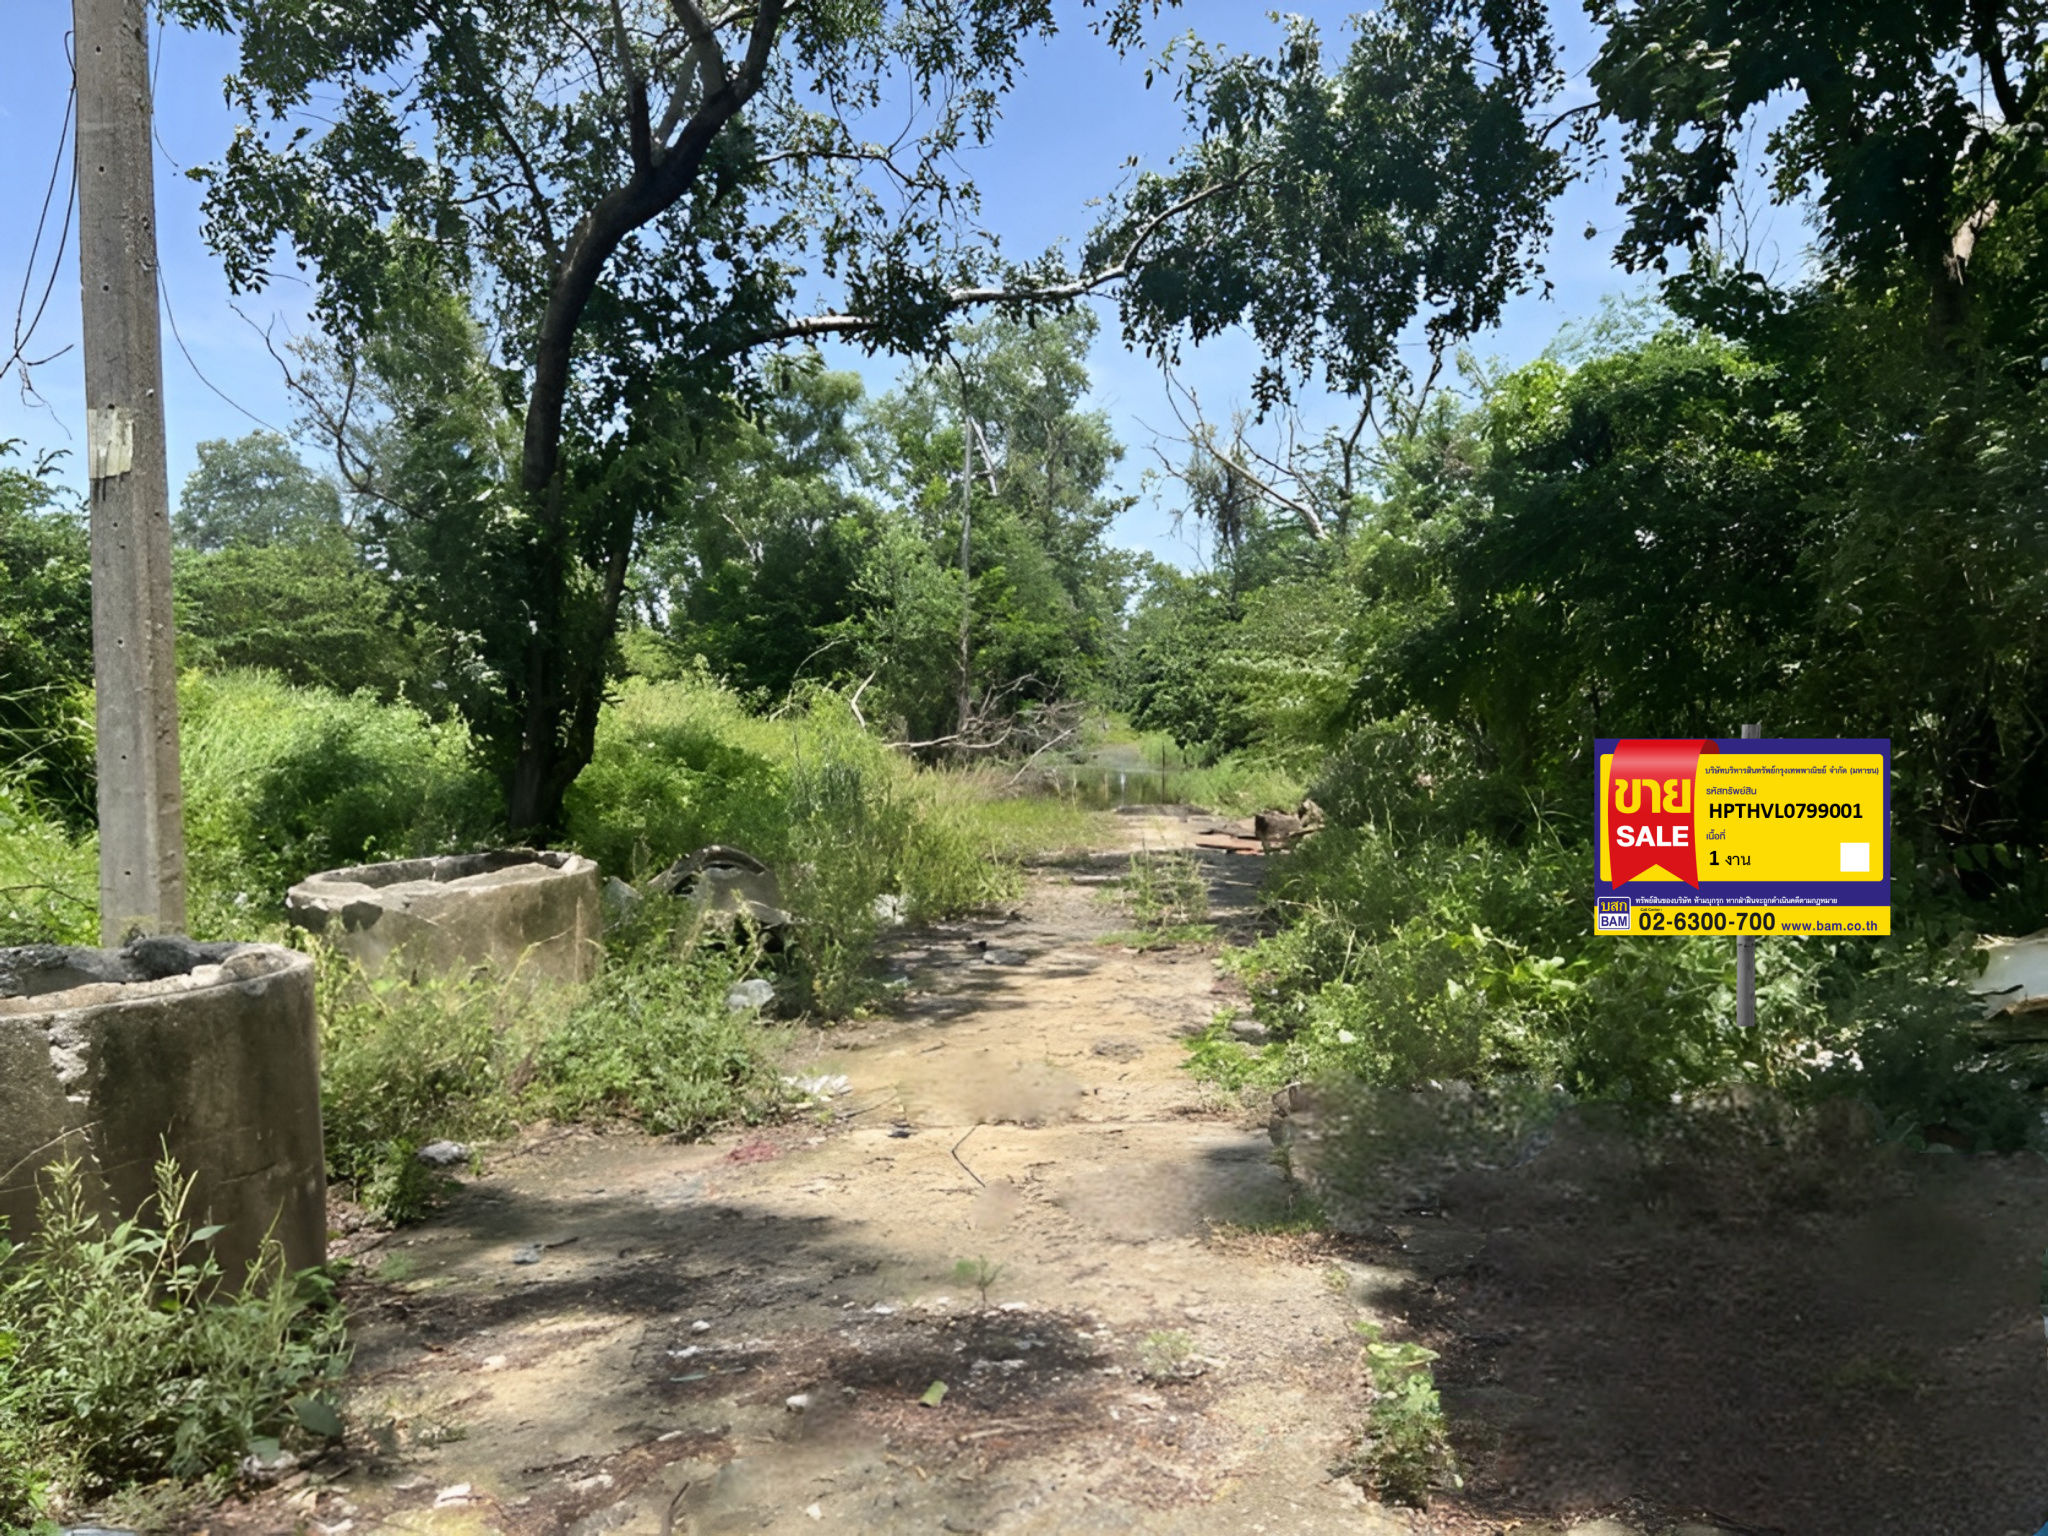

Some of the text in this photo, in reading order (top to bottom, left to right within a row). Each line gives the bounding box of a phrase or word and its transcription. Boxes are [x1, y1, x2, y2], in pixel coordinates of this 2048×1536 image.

[1830, 766, 1848, 774] จำกัด
[1849, 767, 1880, 776] (มหาชน)
[1614, 778, 1692, 814] ขาย
[1706, 786, 1757, 795] รหัสทรัพย์สิน
[1709, 803, 1863, 819] HPTHVL0799001
[1616, 825, 1689, 847] SALE
[1706, 829, 1726, 841] เนื้อที่
[1709, 850, 1751, 866] 1 งาน
[1601, 901, 1628, 912] บสก
[1694, 896, 1724, 906] ห้ามบุกรุก
[1601, 915, 1628, 927] BAM
[1639, 912, 1776, 931] 02-6300-700
[1782, 920, 1878, 931] www.bam.co.th
